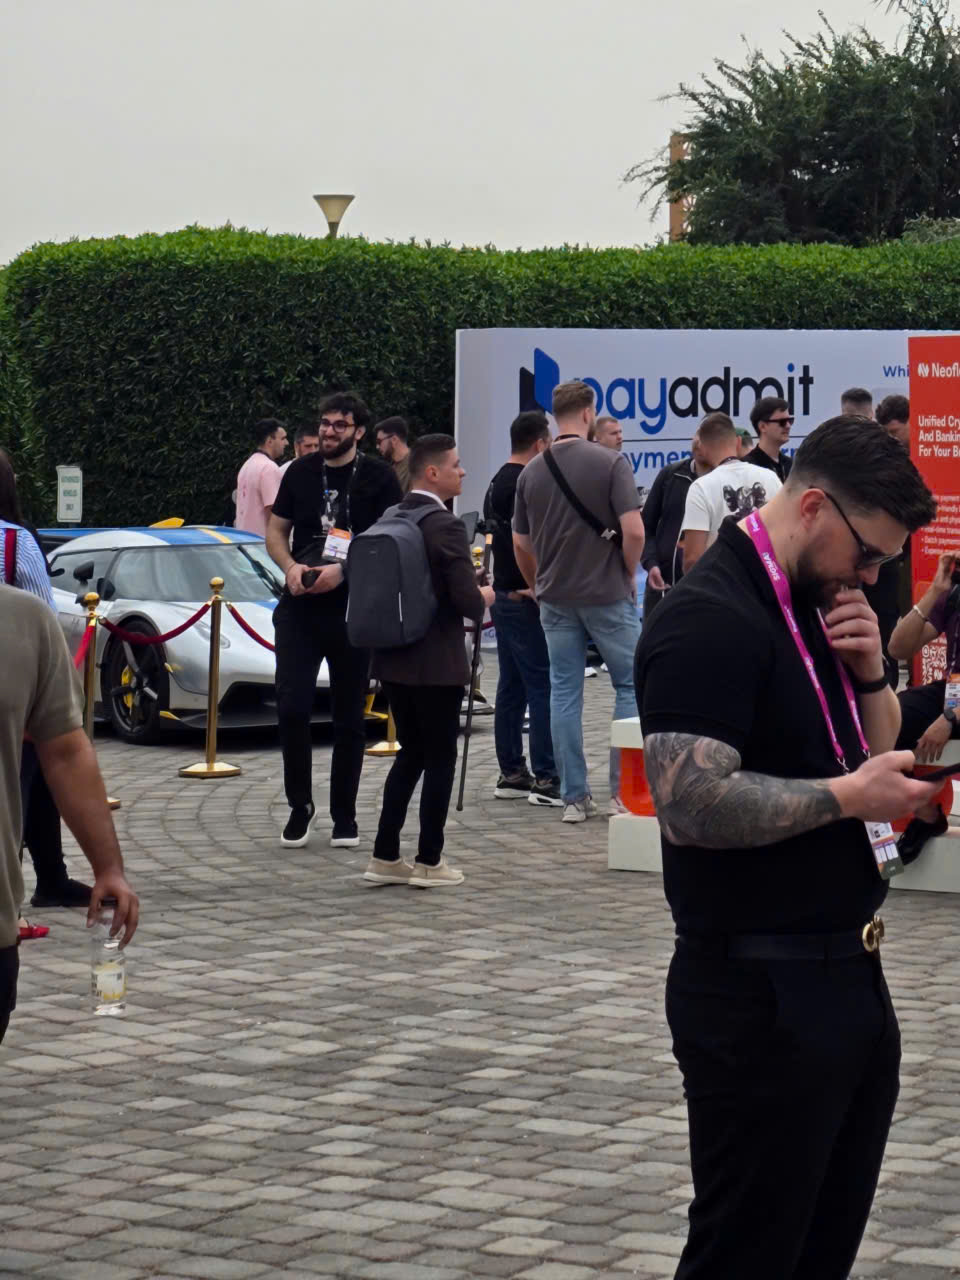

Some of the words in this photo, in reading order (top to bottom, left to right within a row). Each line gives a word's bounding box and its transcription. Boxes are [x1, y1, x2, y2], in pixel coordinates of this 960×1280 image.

[918, 415, 946, 427] Unified
[919, 430, 934, 442] And
[919, 445, 931, 457] For
[932, 445, 951, 458] Your
